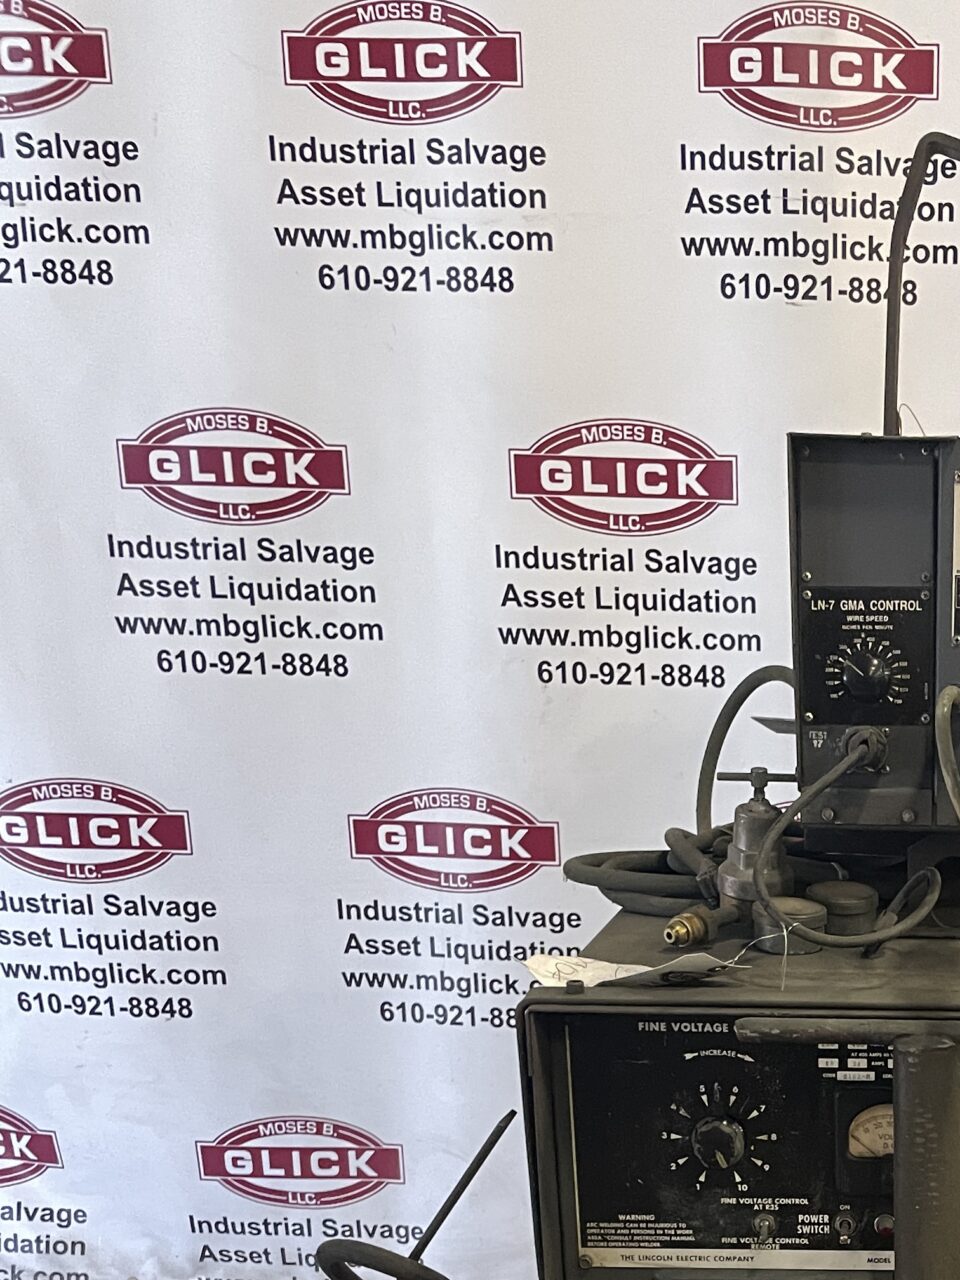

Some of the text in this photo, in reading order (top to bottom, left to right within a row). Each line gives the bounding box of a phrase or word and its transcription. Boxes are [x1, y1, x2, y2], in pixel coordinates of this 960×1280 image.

[357, 3, 445, 22] MOSES B.
[316, 42, 490, 77] GLICK
[389, 101, 425, 118] LLC.
[269, 135, 546, 172] Industrial Salvage
[277, 179, 546, 214] Asset Liquidation
[274, 224, 553, 256] www.mbglick.com
[319, 264, 514, 292] 610-921-8848
[186, 415, 272, 434] MOSES B.
[149, 450, 319, 485] GLICK
[220, 504, 255, 519] LLC.
[108, 534, 374, 570] Industrial Salvage
[117, 573, 376, 606] Asset Liquidation
[812, 600, 922, 610] LN-7 GMA CONTROL
[115, 613, 383, 643] www.mbglick.com
[157, 650, 348, 677] 610-921-8848
[638, 1022, 728, 1032] FINE VOLTAGE
[259, 1121, 338, 1138] MOSES B.
[224, 1150, 378, 1176] GLICK
[288, 1192, 321, 1206] LLC.
[189, 1215, 424, 1242] Industrial Salvage
[797, 1225, 829, 1233] SWITCH
[798, 1215, 829, 1223] POWER
[199, 1245, 273, 1265] Asset
